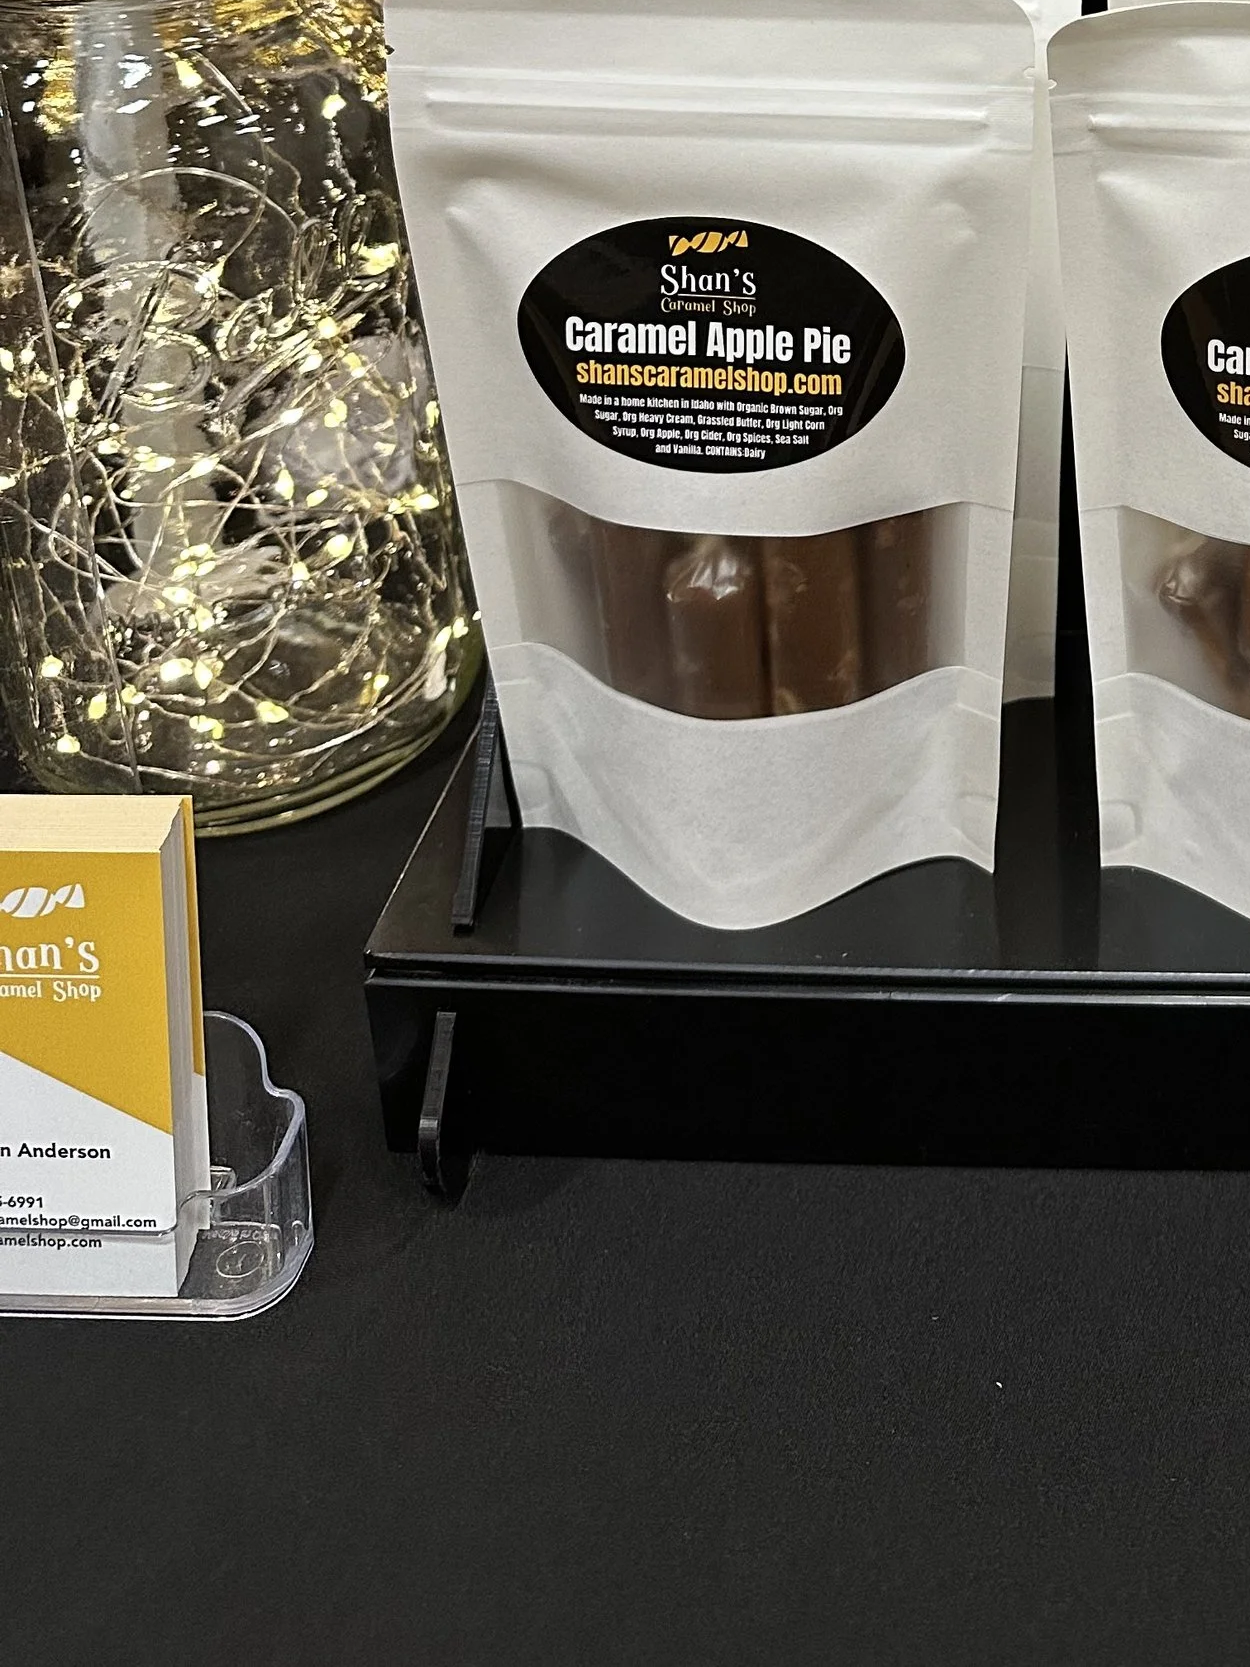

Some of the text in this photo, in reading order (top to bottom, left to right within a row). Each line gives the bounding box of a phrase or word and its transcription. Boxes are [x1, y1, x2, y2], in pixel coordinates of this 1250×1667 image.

[660, 264, 755, 297] Shan's
[660, 297, 755, 316] Caramel Shop
[565, 315, 850, 363] Caramel Apple Pie
[576, 360, 841, 394] shanscaramelshop.com
[579, 393, 602, 404] Made
[603, 394, 612, 405] in
[613, 396, 619, 405] a
[620, 396, 645, 407] home
[646, 397, 679, 408] kitchen
[680, 397, 689, 408] in
[690, 399, 714, 410] Idaho
[716, 400, 734, 411] with
[736, 401, 768, 413] Organic
[770, 403, 796, 414] Brown
[827, 405, 842, 415] Org
[622, 411, 637, 423] Org
[638, 412, 664, 424] Heavy
[697, 414, 734, 426] Grassfed
[765, 418, 780, 429] Org
[782, 418, 803, 430] Light
[804, 419, 824, 430] Corn
[640, 427, 655, 439] Org
[684, 429, 699, 440] Org
[726, 431, 741, 443] Org
[774, 433, 790, 444] Sea
[792, 434, 808, 444] Salt
[655, 443, 671, 453] and
[53, 980, 101, 1002] Shop
[18, 1143, 111, 1159] Anderson
